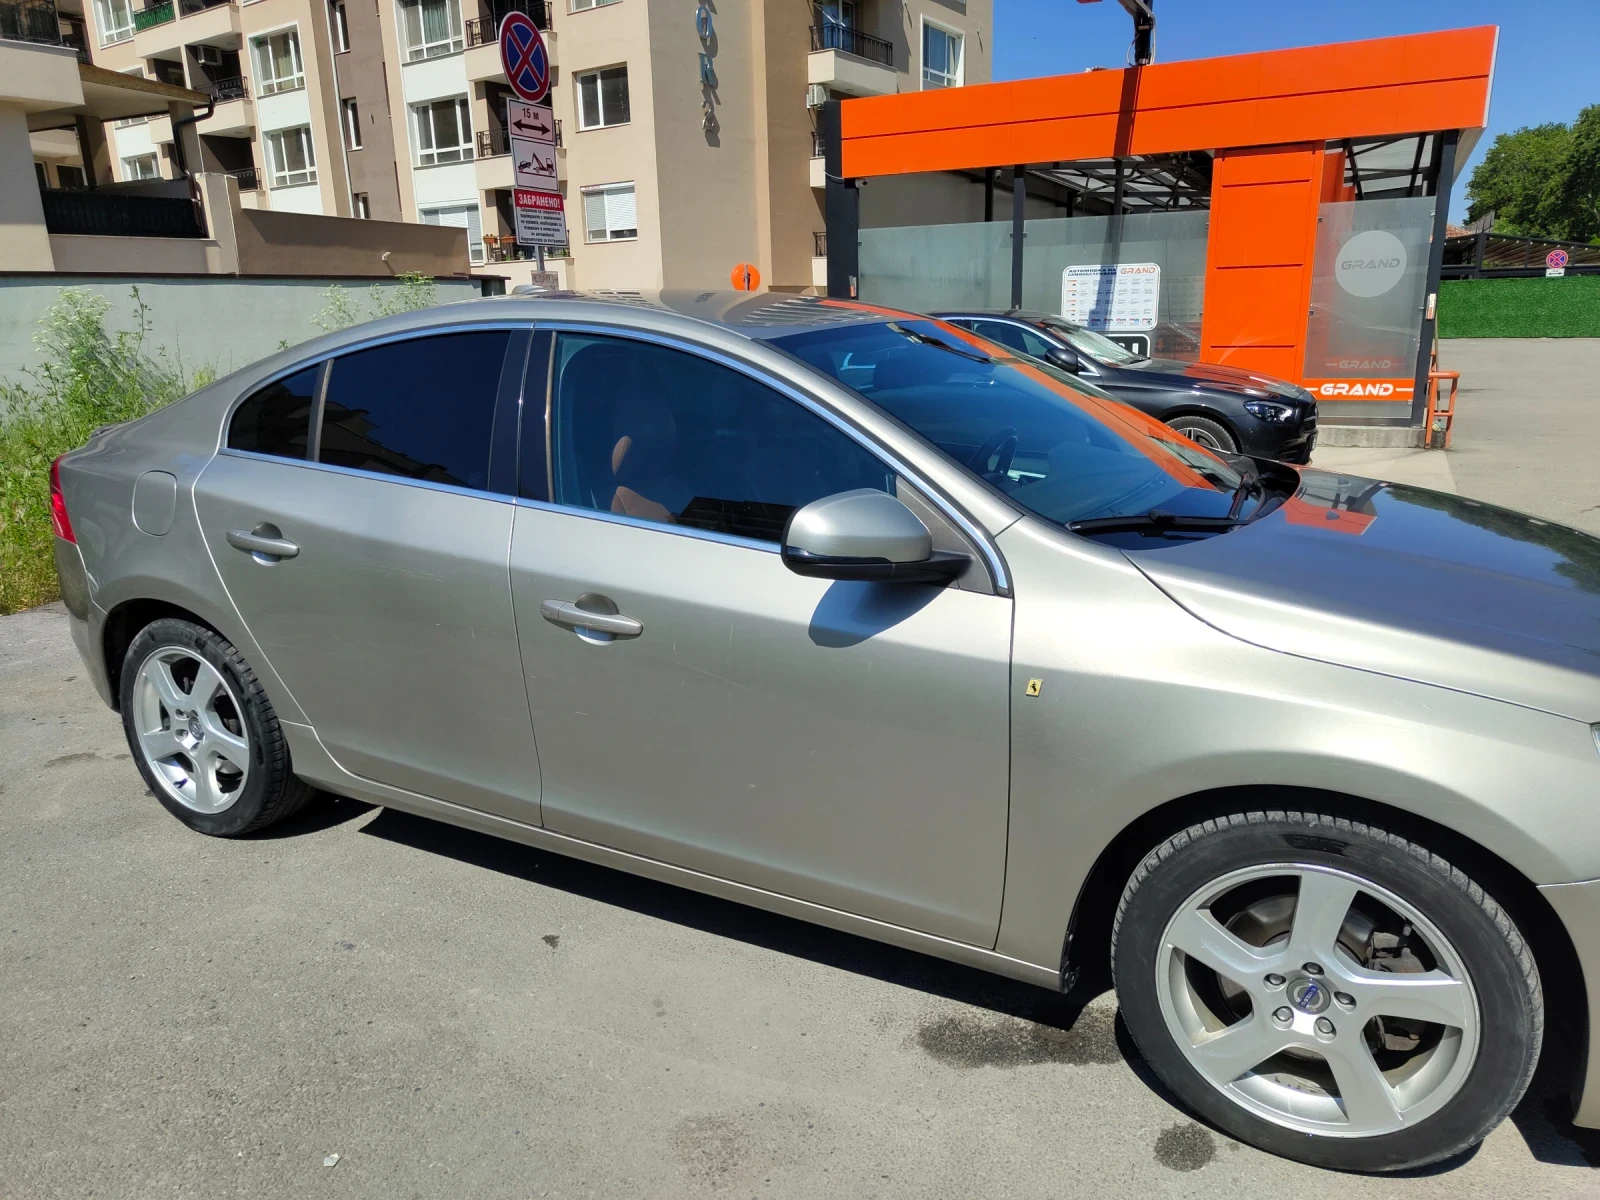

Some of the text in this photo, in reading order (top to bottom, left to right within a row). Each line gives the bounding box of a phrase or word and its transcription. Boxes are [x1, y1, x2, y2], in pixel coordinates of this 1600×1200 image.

[522, 107, 531, 119] 15
[518, 193, 561, 209] ЗАБРАНЕНО!
[1340, 258, 1401, 271] GRAND
[1120, 267, 1156, 275] GRAND
[1338, 359, 1392, 369] GRAND
[1320, 383, 1394, 396] GRAND
